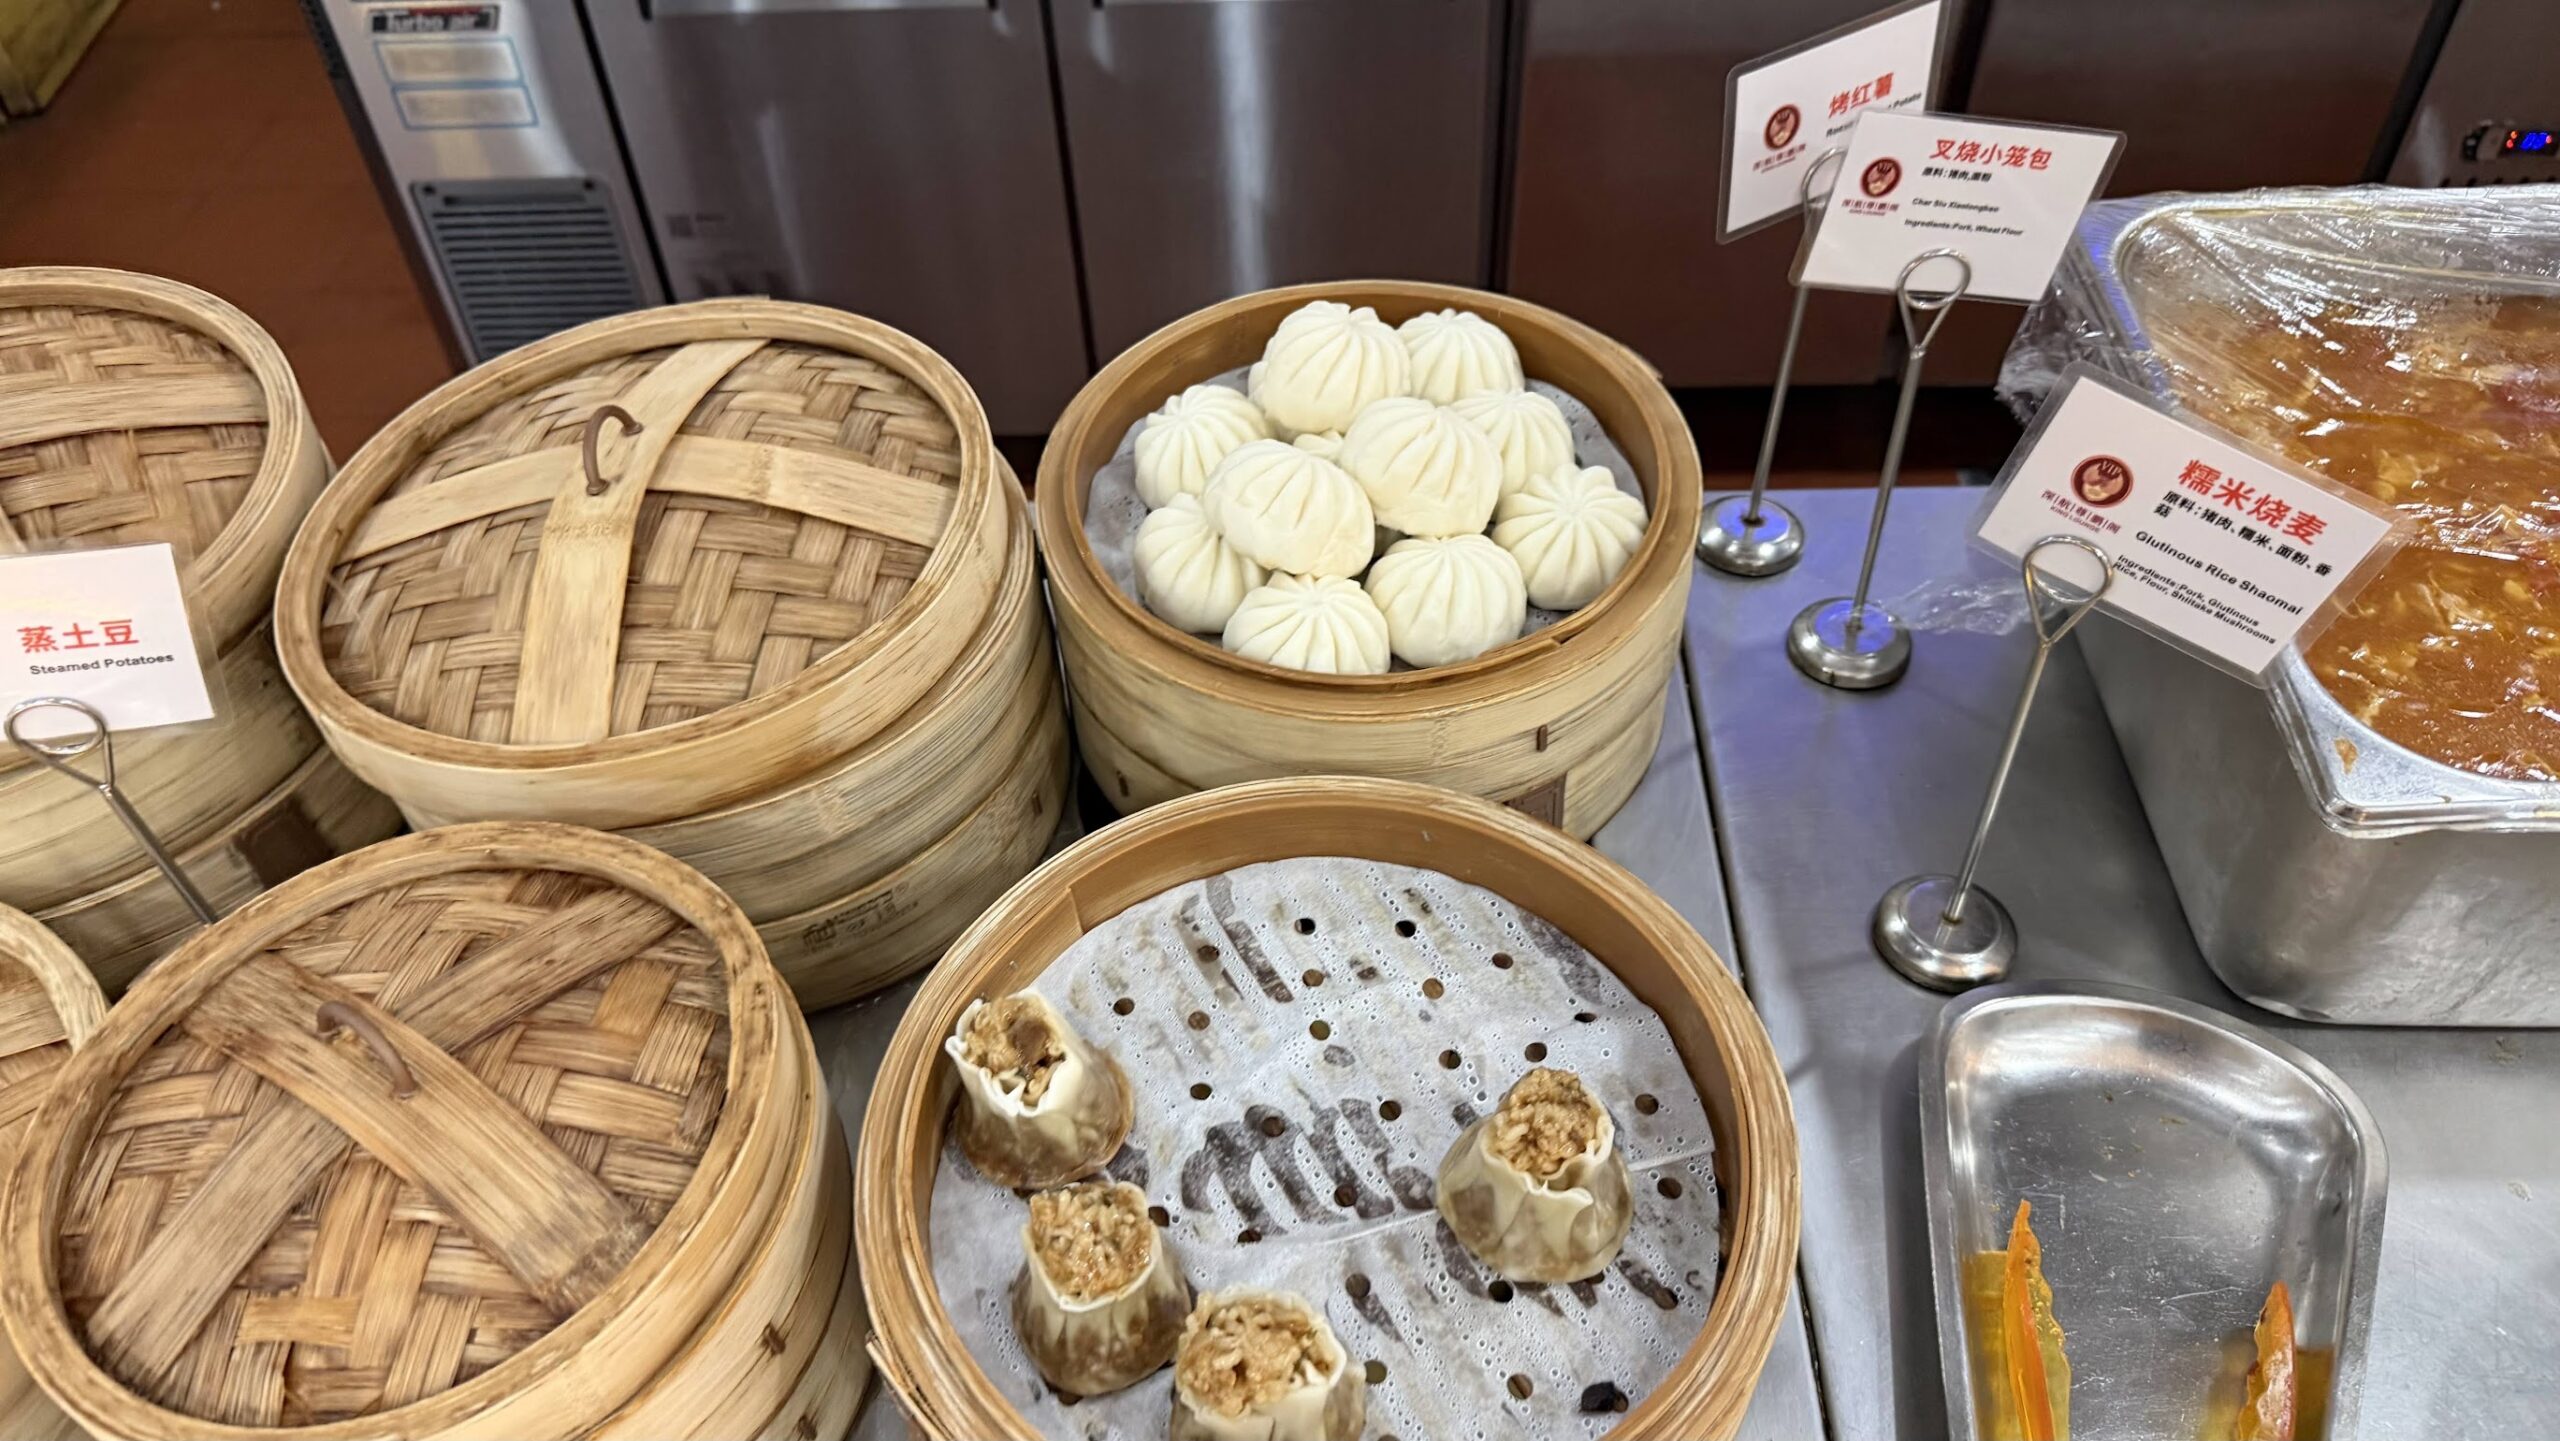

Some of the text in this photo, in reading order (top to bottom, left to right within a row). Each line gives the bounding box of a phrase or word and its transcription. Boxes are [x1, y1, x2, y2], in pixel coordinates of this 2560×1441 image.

[1929, 139, 2053, 171] 叉烧小笼包
[1912, 198, 1932, 206] Char
[1933, 199, 1947, 208] Siu
[1975, 225, 2001, 234] Wheat
[2001, 227, 2024, 236] Flour
[2178, 460, 2328, 545] 糯米烧麦
[2136, 531, 2304, 616] Glutinous Rice Shaomai
[2113, 562, 2277, 645] Rice, Flour, Shiitake Mushrooms
[2208, 598, 2260, 627] Glutinous
[17, 619, 140, 654] 蒸土豆
[29, 653, 175, 676] Steamed Potatoes
